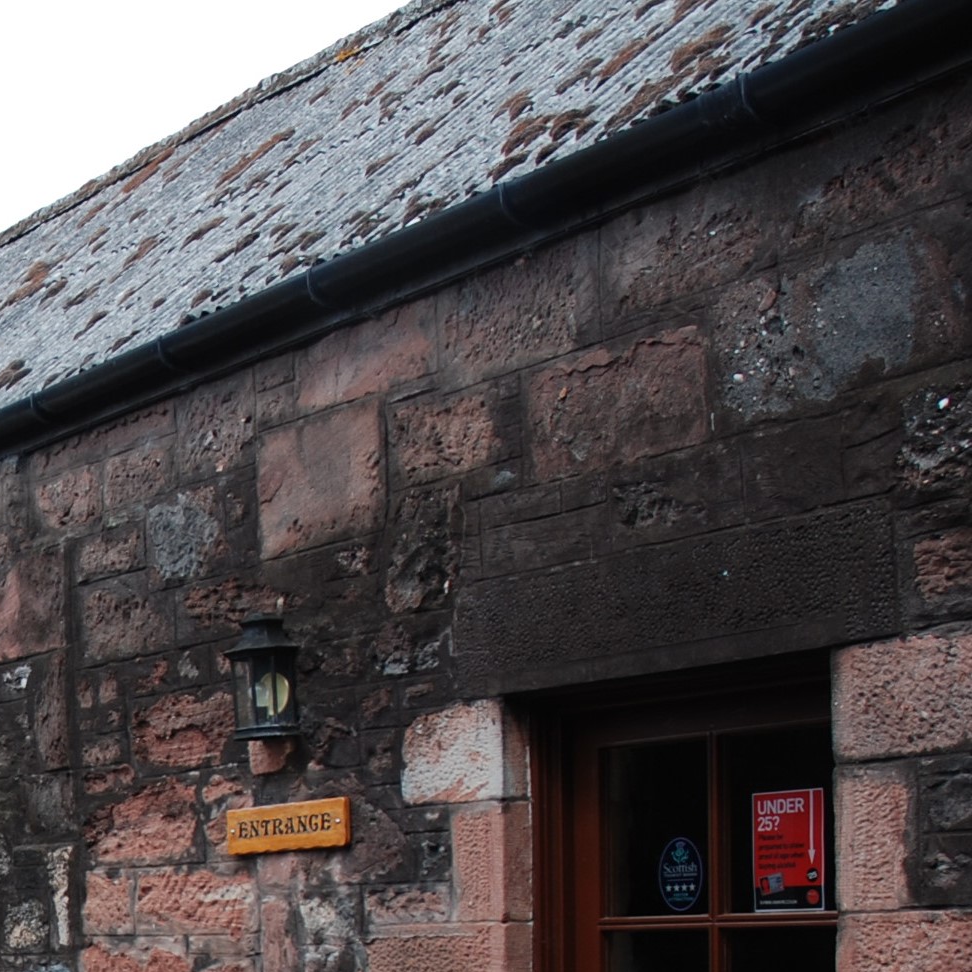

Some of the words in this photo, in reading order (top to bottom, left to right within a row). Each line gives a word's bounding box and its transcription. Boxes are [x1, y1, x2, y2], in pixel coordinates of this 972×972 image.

[757, 797, 805, 815] UNDER
[238, 812, 331, 839] ENTRANCE
[757, 816, 780, 832] 25?
[663, 861, 698, 874] Scottish
